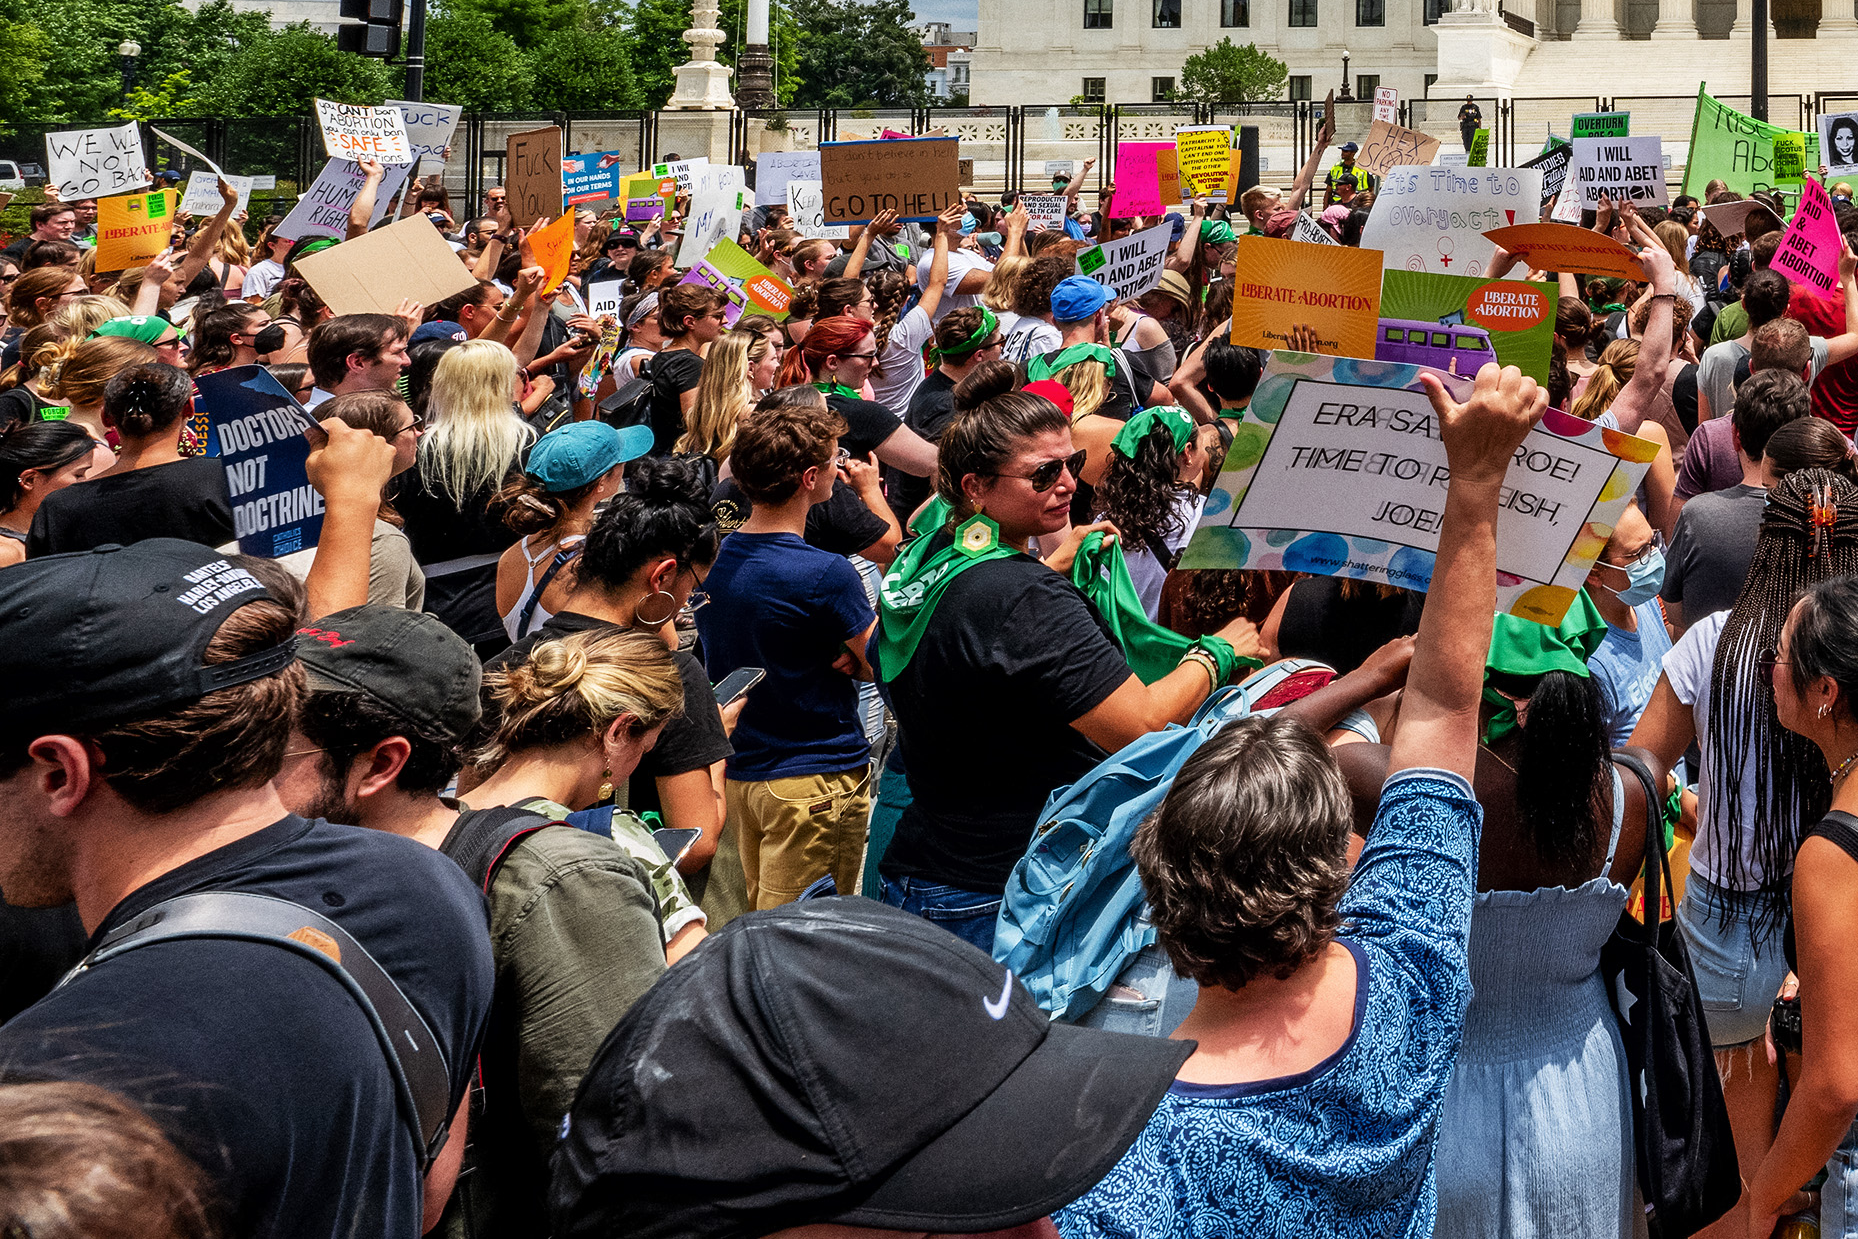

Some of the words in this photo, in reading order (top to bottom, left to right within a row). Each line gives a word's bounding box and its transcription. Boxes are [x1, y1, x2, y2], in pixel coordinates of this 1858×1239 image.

[1376, 97, 1395, 107] PARKING
[1382, 89, 1391, 98] NO
[319, 102, 337, 116] you
[374, 108, 397, 116] ban
[330, 113, 395, 129] ABORTION
[1578, 117, 1624, 130] OVERTURN
[323, 125, 339, 136] you
[342, 127, 360, 136] can
[383, 128, 405, 137] ban
[49, 133, 102, 160] WE
[339, 133, 388, 153] SAFE
[1180, 138, 1214, 147] PATRIARCHY
[1180, 145, 1214, 153] CAPITALISM
[1384, 126, 1427, 157] HEX
[1775, 146, 1803, 154] SCOTUS
[79, 150, 135, 175] NOT
[1182, 158, 1209, 166] WITHOUT
[1209, 156, 1230, 164] ENDING
[1597, 147, 1600, 162] I
[1604, 146, 1632, 161] WILL
[567, 178, 575, 186] IN
[575, 175, 588, 184] OUR
[589, 172, 611, 183] HANDS
[1197, 177, 1224, 185] NOTHING
[1579, 166, 1595, 182] AID
[1598, 166, 1621, 182] AND
[1624, 166, 1658, 181] ABET
[59, 178, 100, 198] GO
[576, 184, 589, 193] OUR
[590, 181, 612, 192] TERMS
[1808, 184, 1815, 197] I
[829, 194, 865, 218] GO
[869, 194, 898, 213] TO
[904, 191, 951, 215] HELL
[1046, 207, 1062, 215] CARE
[1803, 201, 1821, 221] AID
[104, 223, 160, 240] LIBERATE
[1796, 216, 1806, 231] &
[1110, 249, 1114, 265] I
[1119, 240, 1147, 261] WILL
[1786, 233, 1818, 259] ABET
[1108, 264, 1135, 285] AND
[1137, 249, 1165, 276] ABET
[1778, 249, 1834, 291] ABORTION
[751, 282, 785, 311] ABORTION
[760, 278, 790, 305] LIBERATE
[1241, 283, 1296, 304] LIBERATE
[1298, 290, 1373, 312] ABORTION
[1484, 291, 1539, 306] LIBERATE
[595, 299, 616, 313] AID
[1475, 303, 1540, 318] ABORTION
[1312, 402, 1378, 428] ERA
[216, 404, 312, 457] DOCTORS
[1290, 446, 1367, 473] TIME
[1376, 453, 1421, 481] TO
[225, 454, 269, 499] NOT
[232, 483, 327, 540] DOCTRINE
[1371, 500, 1443, 535] JOE!
[273, 539, 302, 558] CHOICE
[192, 596, 220, 615] LOS
